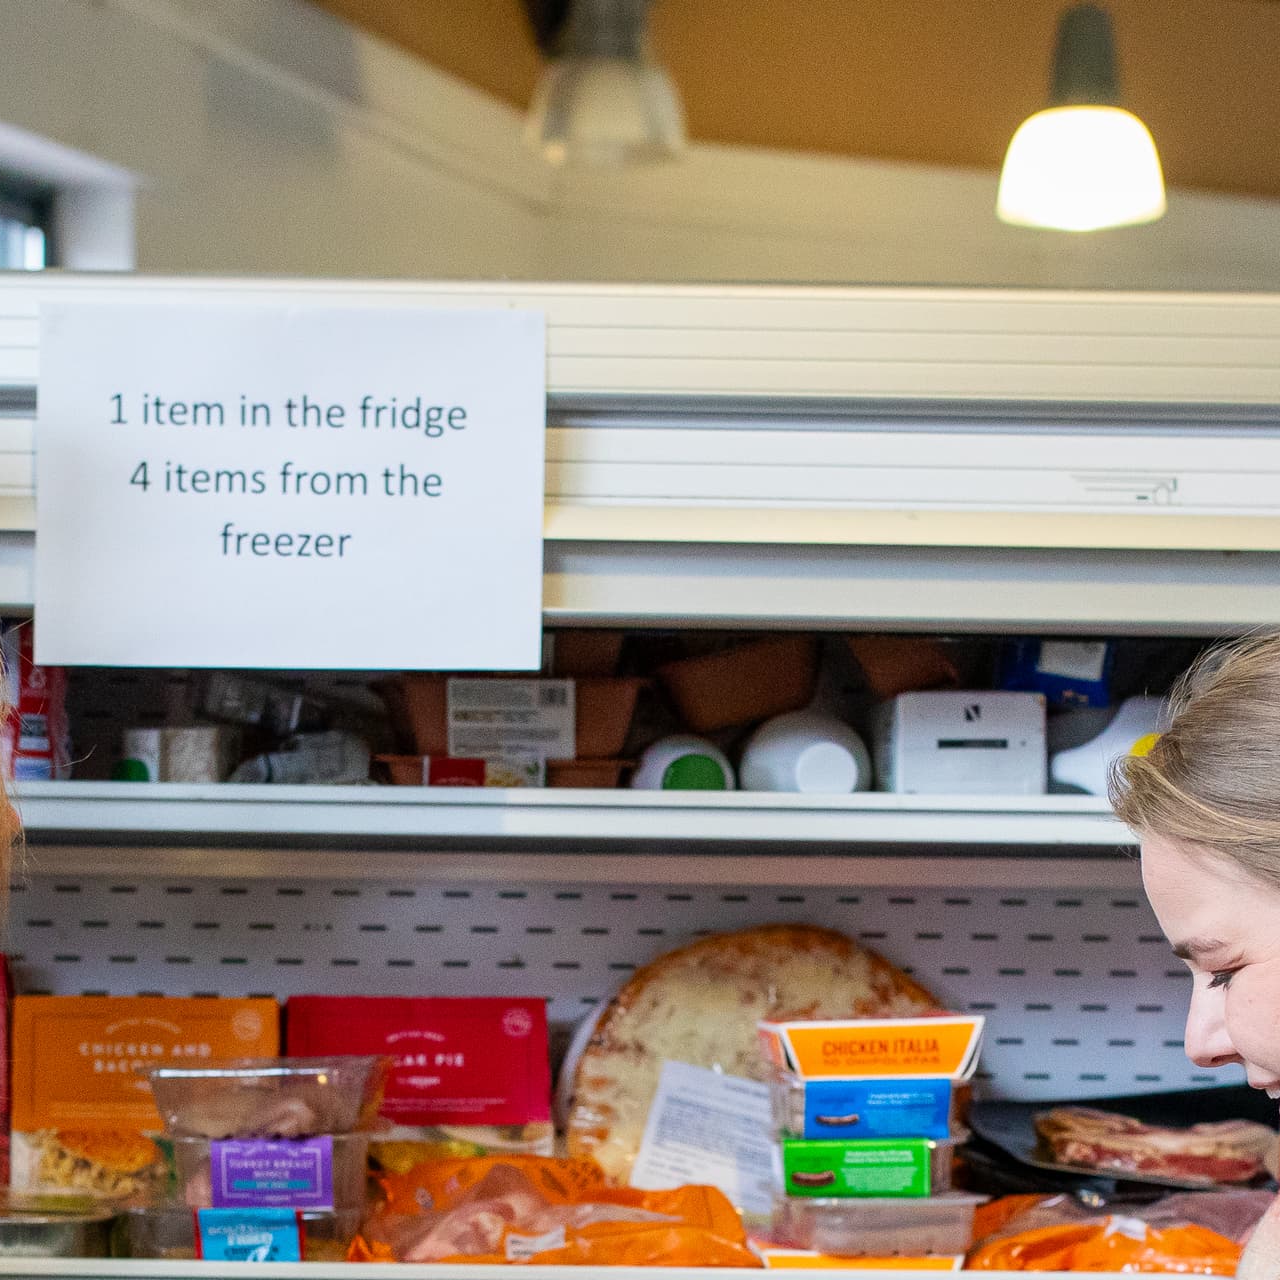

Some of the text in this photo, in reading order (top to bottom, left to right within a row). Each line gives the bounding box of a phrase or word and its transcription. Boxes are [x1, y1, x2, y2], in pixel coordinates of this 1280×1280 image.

[109, 393, 468, 438] 1 item in the fridge
[130, 461, 443, 498] 4 items from the
[221, 523, 352, 558] freezer
[78, 1041, 212, 1058] CHICKEN AND
[821, 1038, 940, 1057] CHICKEN ITALIA
